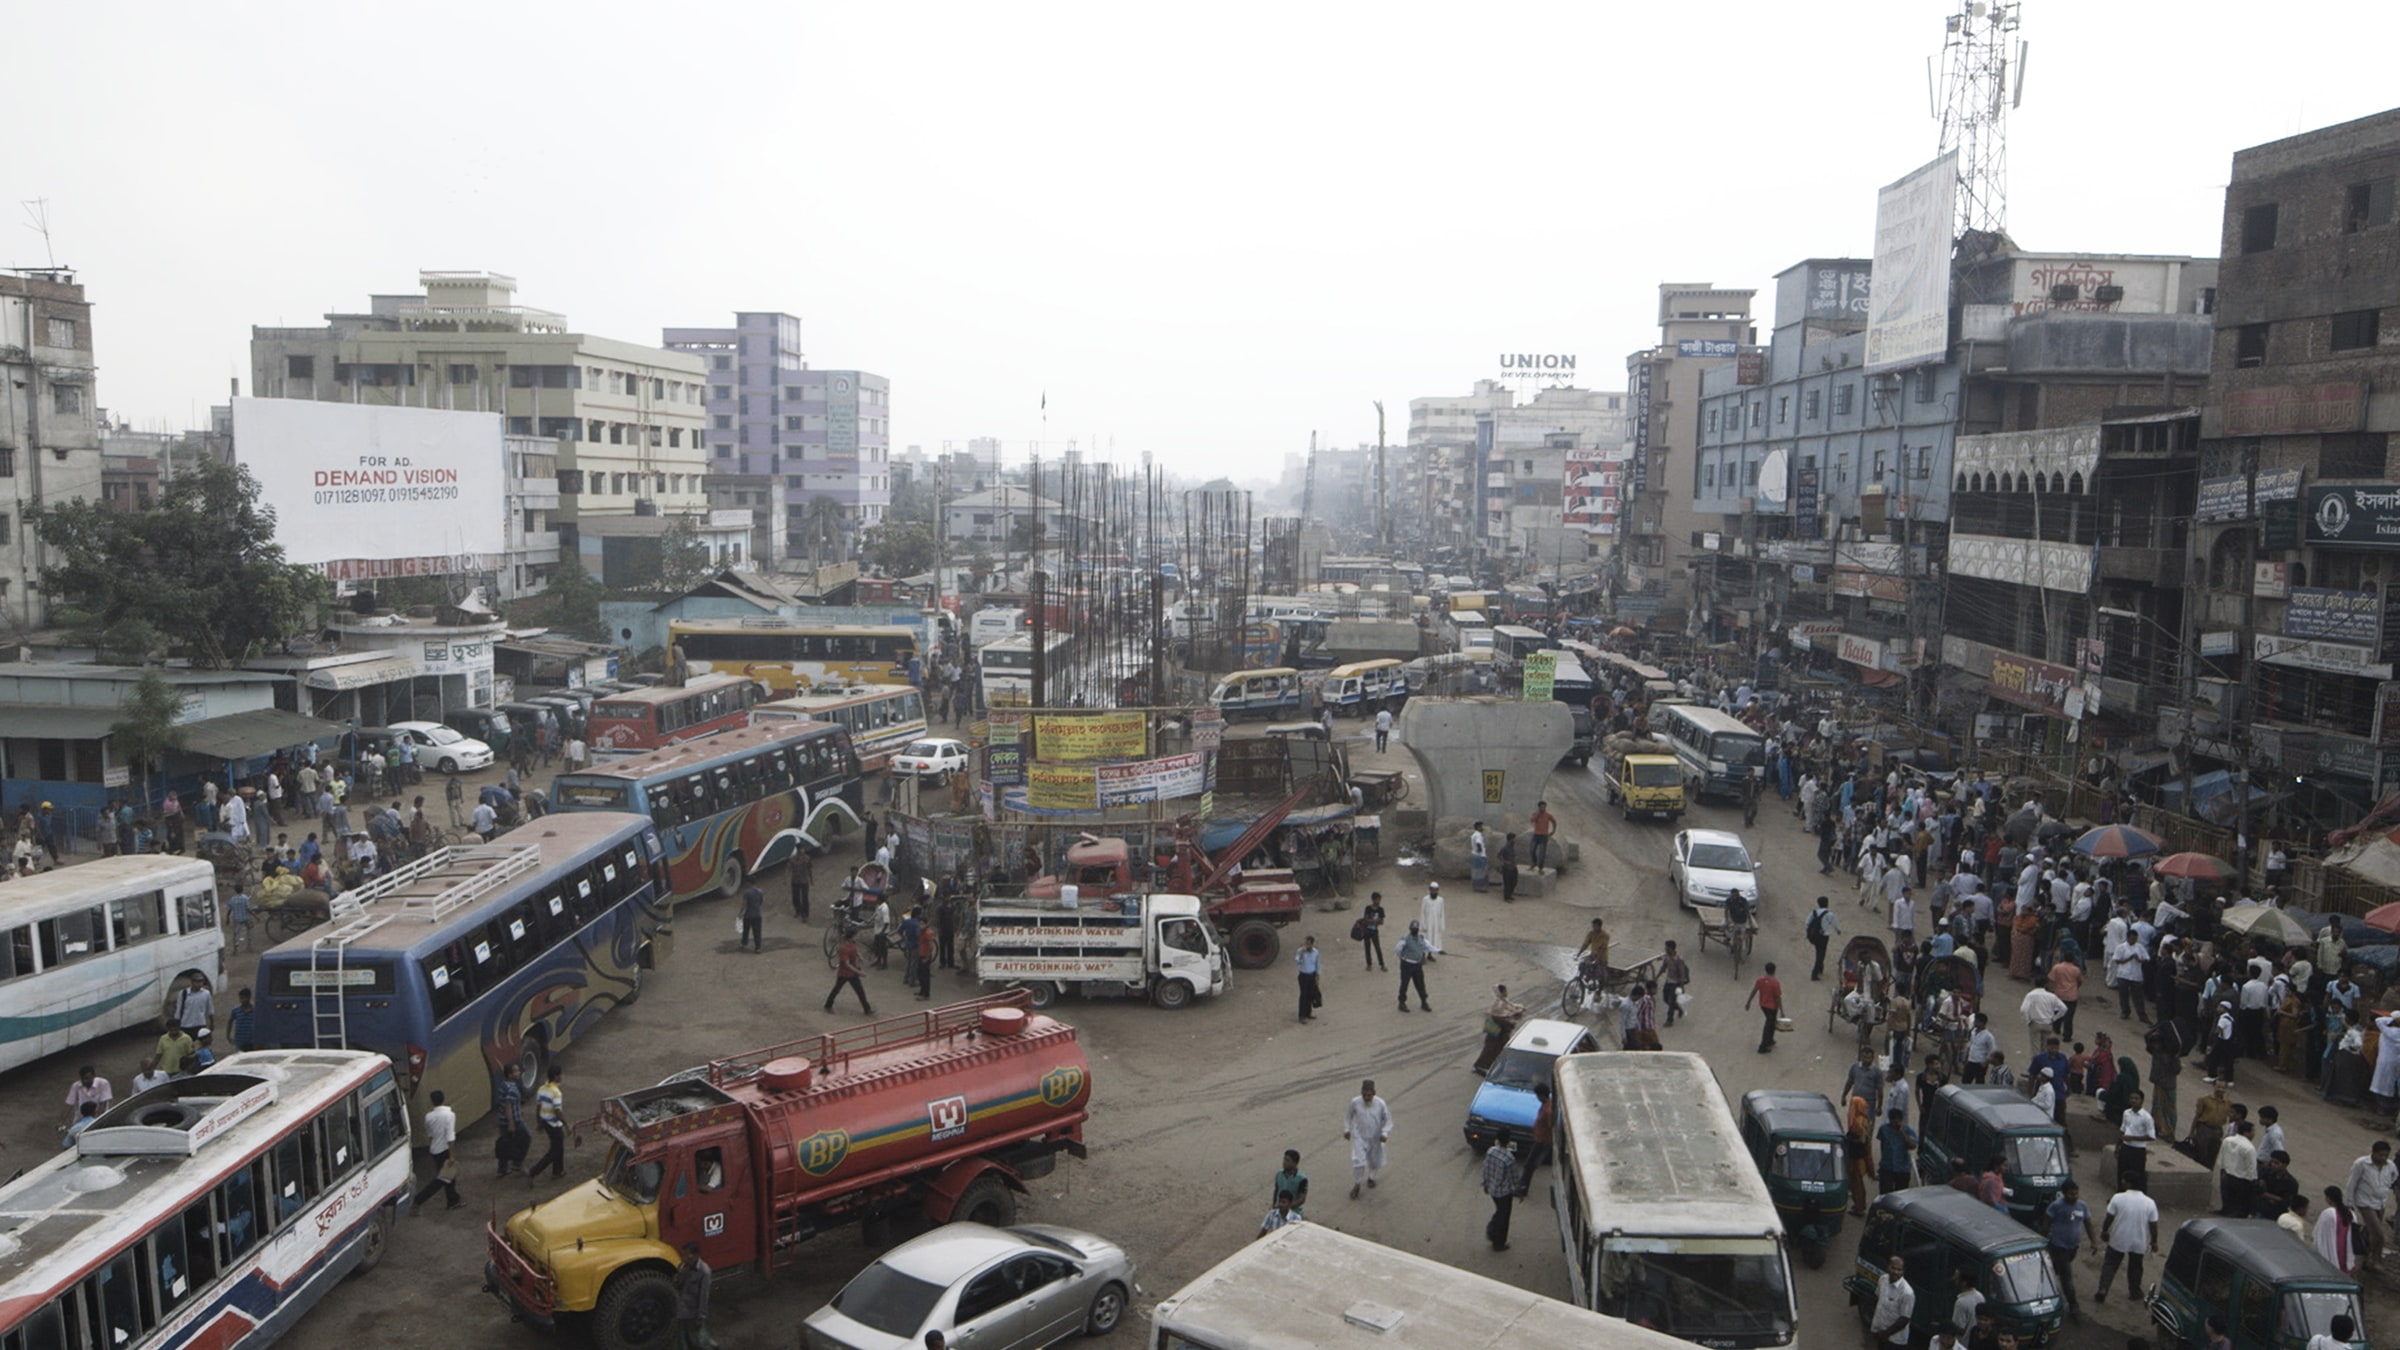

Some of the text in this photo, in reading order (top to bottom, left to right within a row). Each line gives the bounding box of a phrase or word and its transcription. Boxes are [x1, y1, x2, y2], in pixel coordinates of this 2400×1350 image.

[1500, 354, 1576, 368] UNION
[1501, 371, 1576, 379] DEVELOPMENT
[359, 456, 413, 467] FOR AD.
[314, 469, 458, 486] DEMAND VISION
[389, 487, 459, 502] 01915452190
[357, 558, 416, 579] FILLING
[1804, 624, 1841, 633] Bata
[1843, 638, 1873, 664] Bata
[991, 927, 1124, 937] FAITH DRINKING WATER
[995, 962, 1028, 971] FAITH
[1029, 962, 1080, 972] DRINKING
[1049, 1070, 1082, 1100] BP
[931, 1127, 966, 1142] MEGHNA
[808, 1136, 845, 1168] BP
